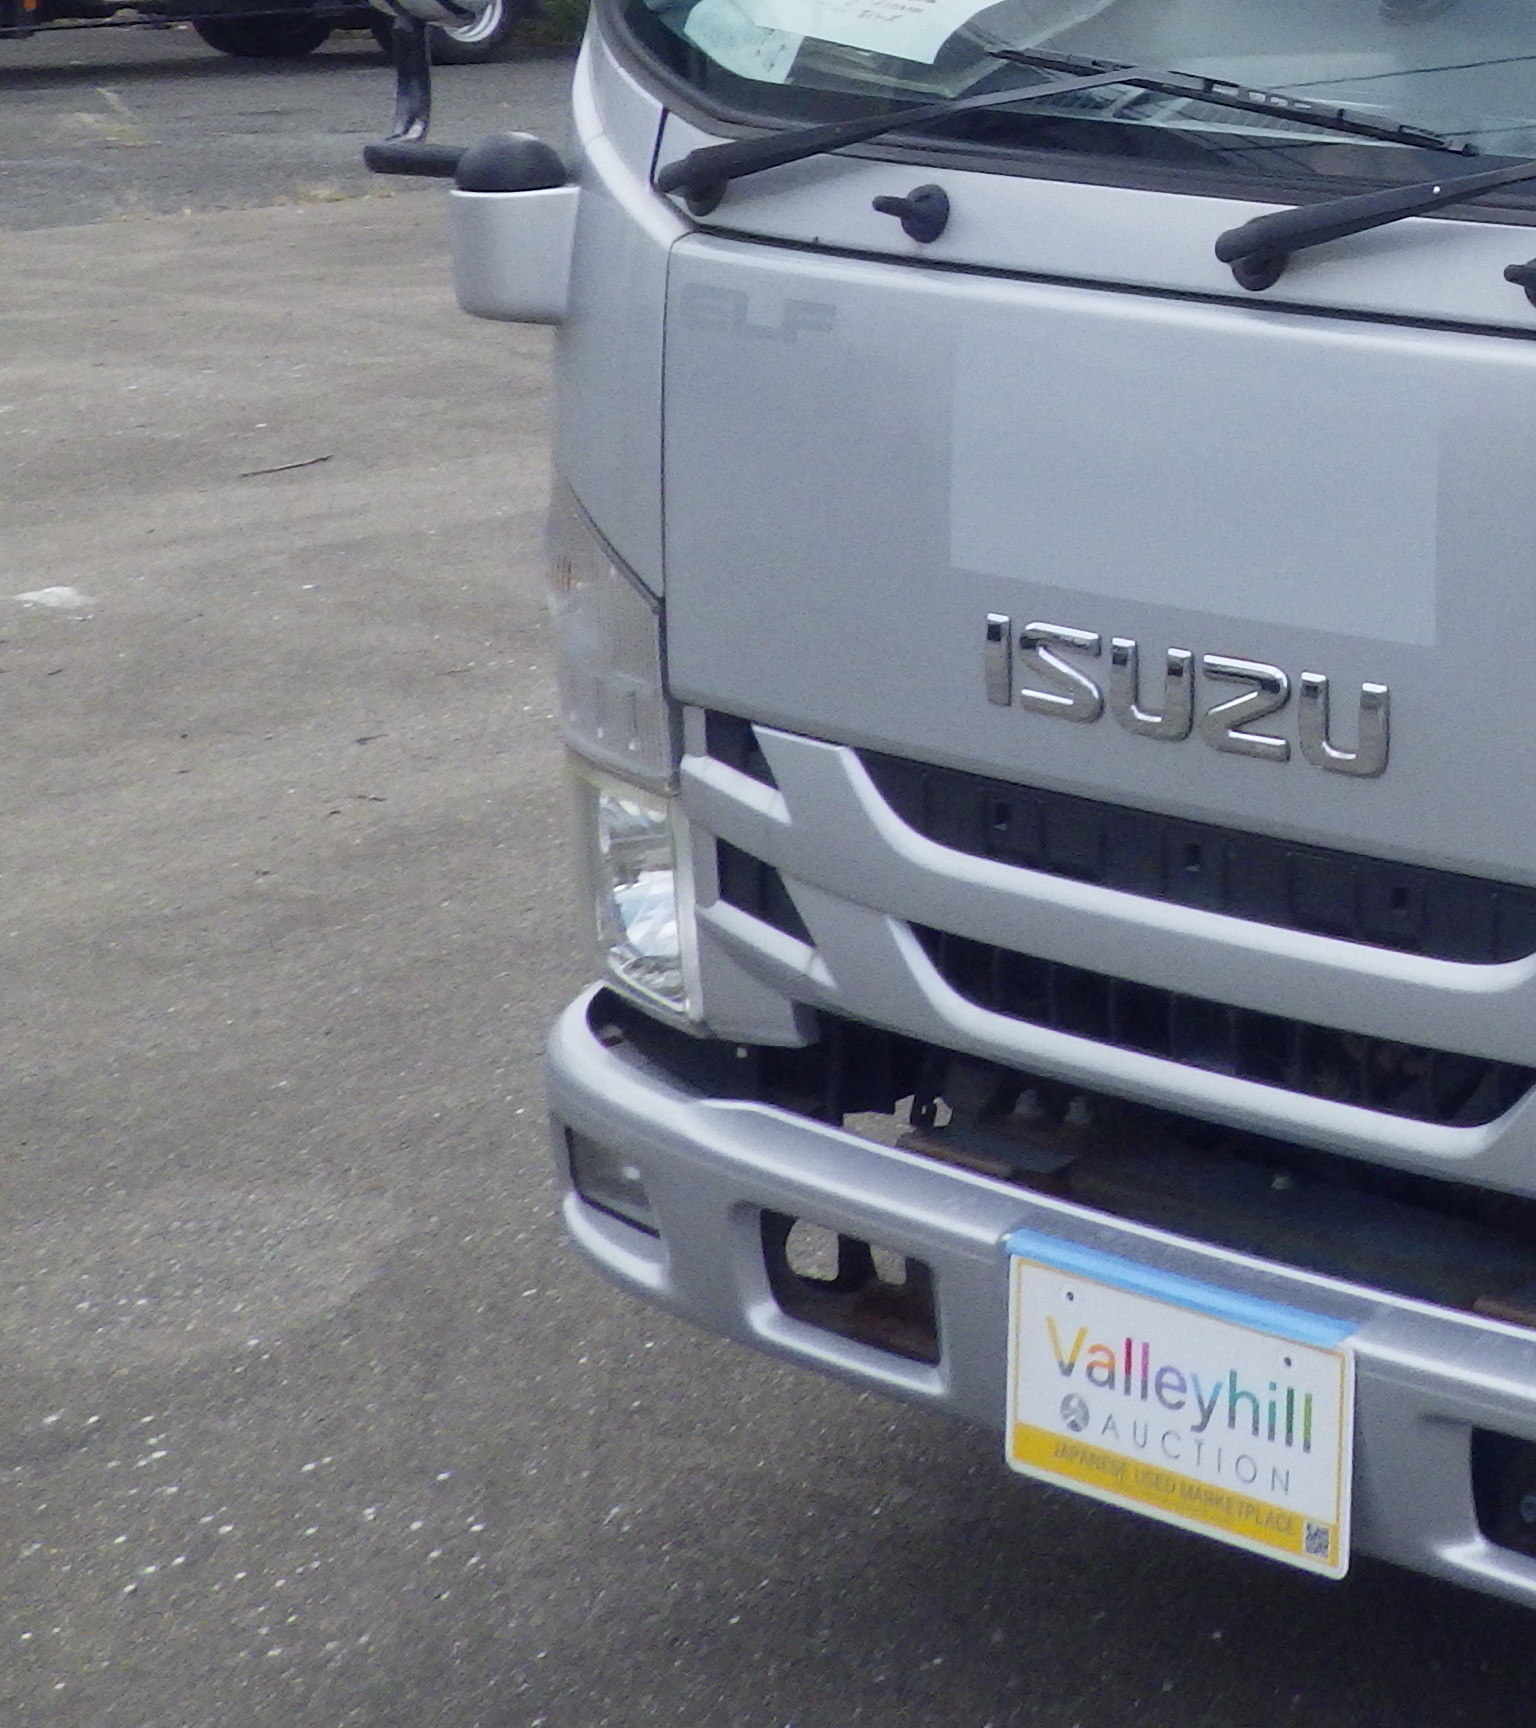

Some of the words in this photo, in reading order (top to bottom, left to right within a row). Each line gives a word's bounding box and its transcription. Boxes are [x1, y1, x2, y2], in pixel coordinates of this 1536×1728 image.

[984, 610, 1392, 779] ISUZU
[1045, 1315, 1314, 1454] Valleyhill
[1101, 1412, 1291, 1497] AUCTION
